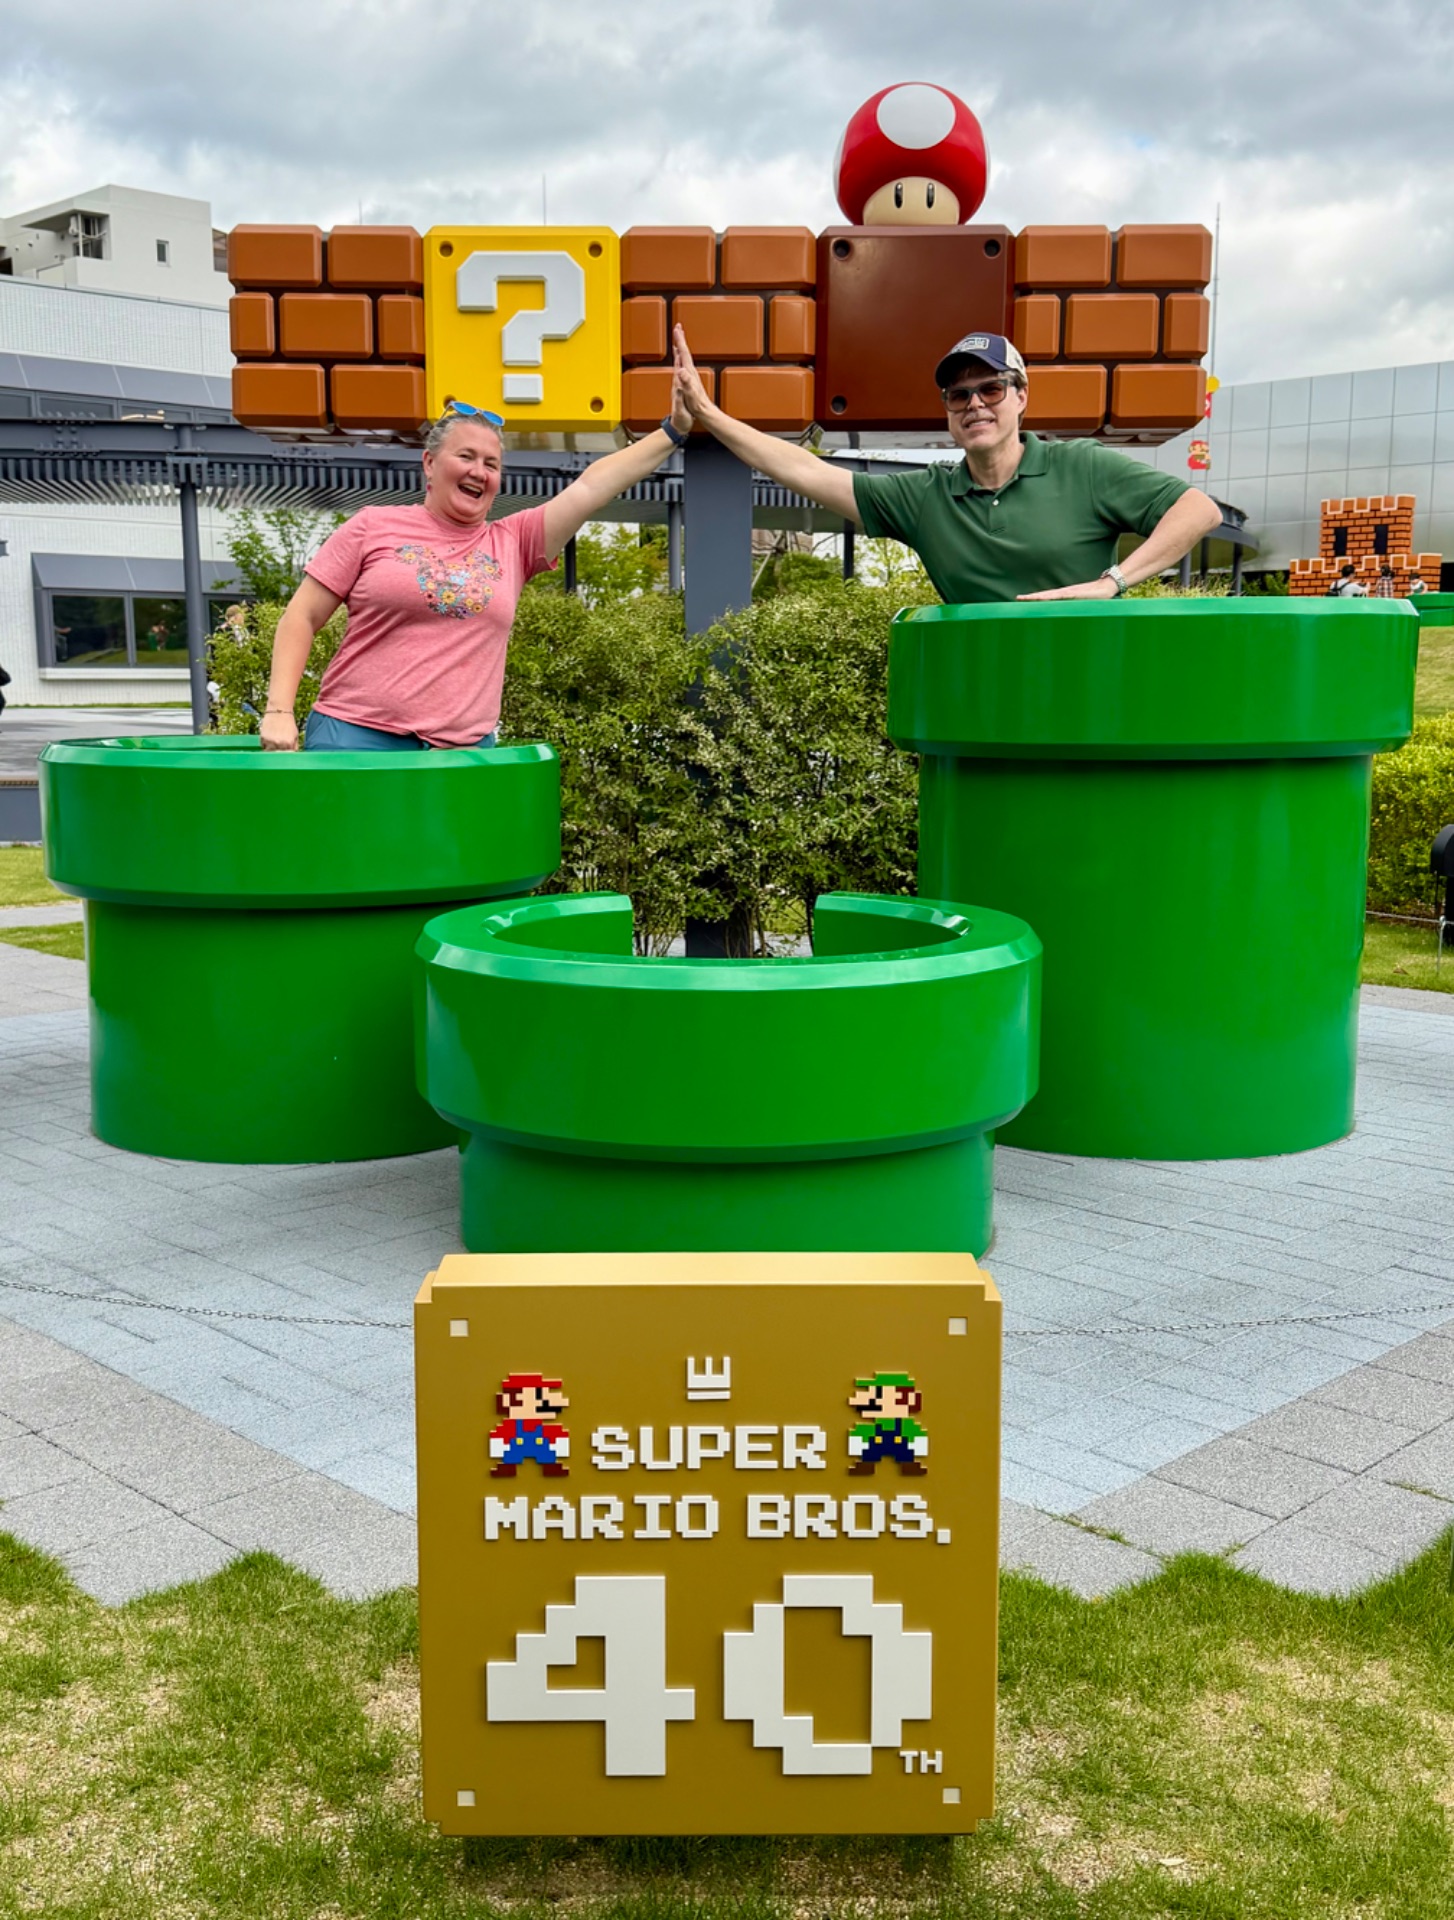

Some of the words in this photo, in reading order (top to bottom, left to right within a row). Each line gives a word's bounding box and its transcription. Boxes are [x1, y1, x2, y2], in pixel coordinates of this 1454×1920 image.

[457, 251, 585, 403] ?
[591, 1426, 826, 1470] SUPER
[485, 1496, 719, 1540] MARIO
[747, 1495, 951, 1543] BROS.
[487, 1575, 932, 1776] 40
[899, 1750, 943, 1774] TH
